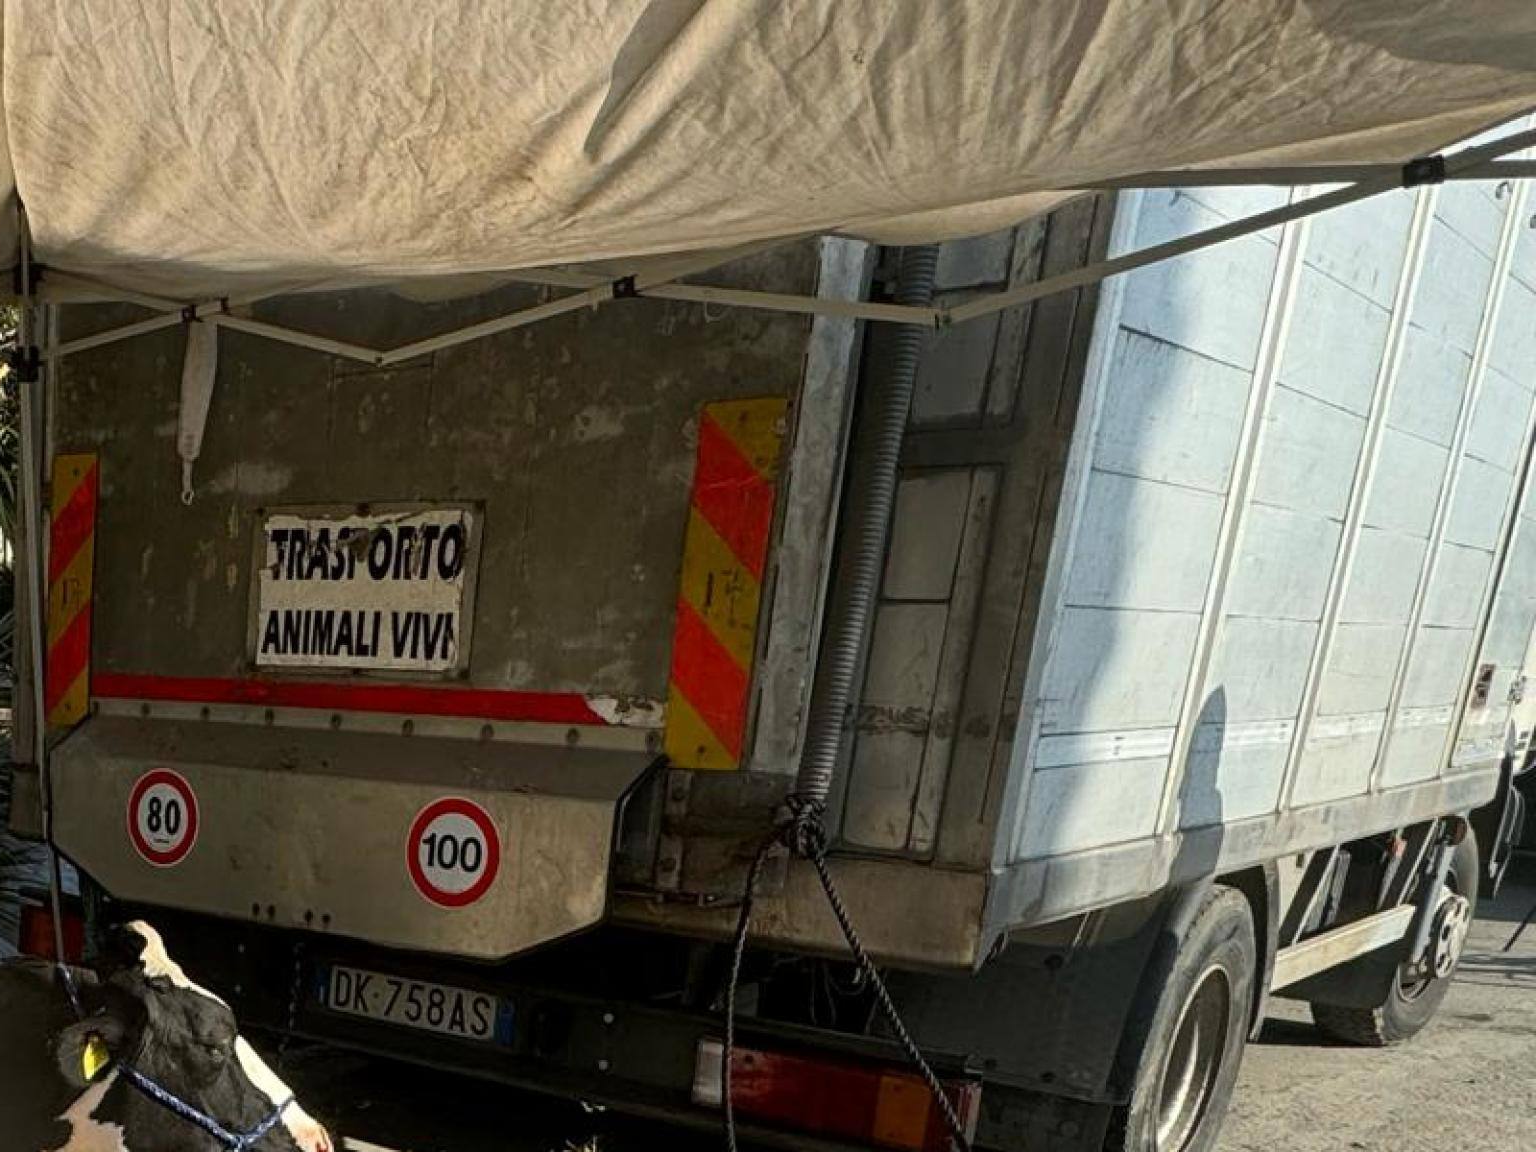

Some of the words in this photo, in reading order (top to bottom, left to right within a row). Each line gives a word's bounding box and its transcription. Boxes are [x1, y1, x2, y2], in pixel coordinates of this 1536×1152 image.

[261, 609, 381, 658] ANIMALI
[147, 796, 181, 836] 80
[422, 832, 483, 873] 100
